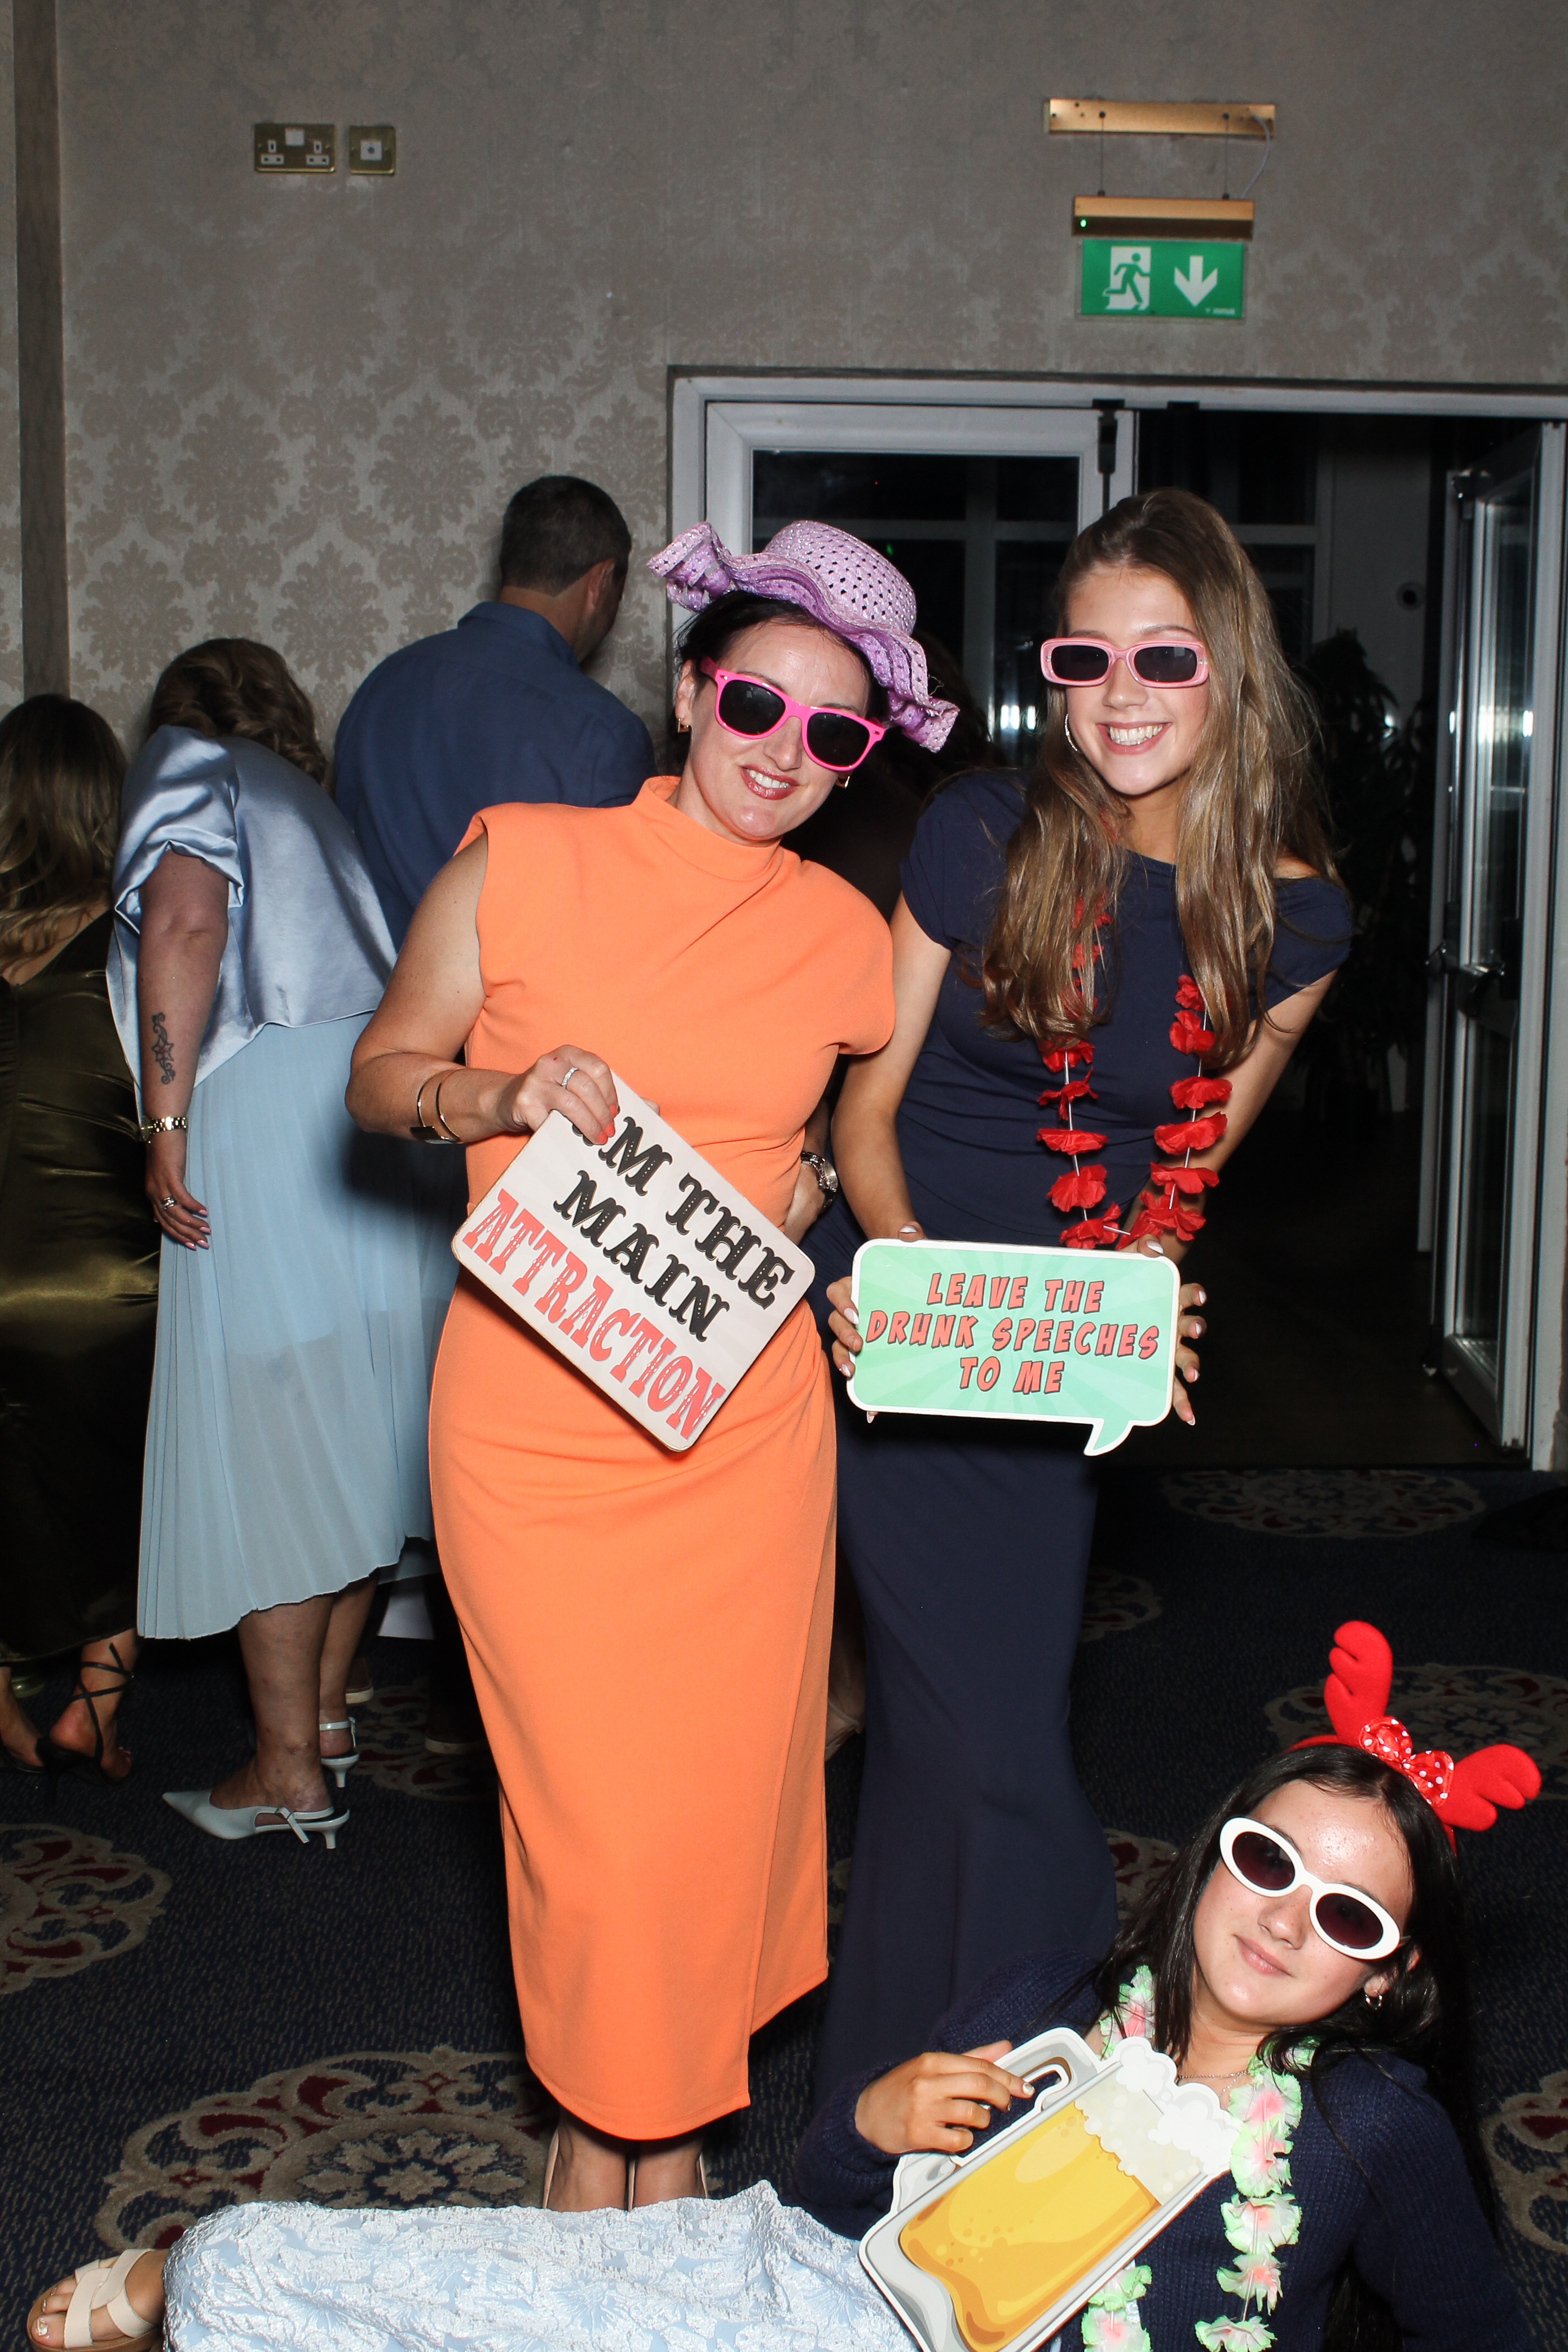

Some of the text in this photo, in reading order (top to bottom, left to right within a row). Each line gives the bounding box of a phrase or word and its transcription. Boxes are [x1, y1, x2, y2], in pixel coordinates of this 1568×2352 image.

[553, 1170, 730, 1342] MAIN
[666, 1172, 795, 1310] THE
[461, 1188, 727, 1440] ATTRACTION
[865, 1310, 1159, 1359] DRUNK SPEECHES
[927, 1272, 1104, 1314] LEAVE THE
[959, 1356, 1065, 1395] TO ME
